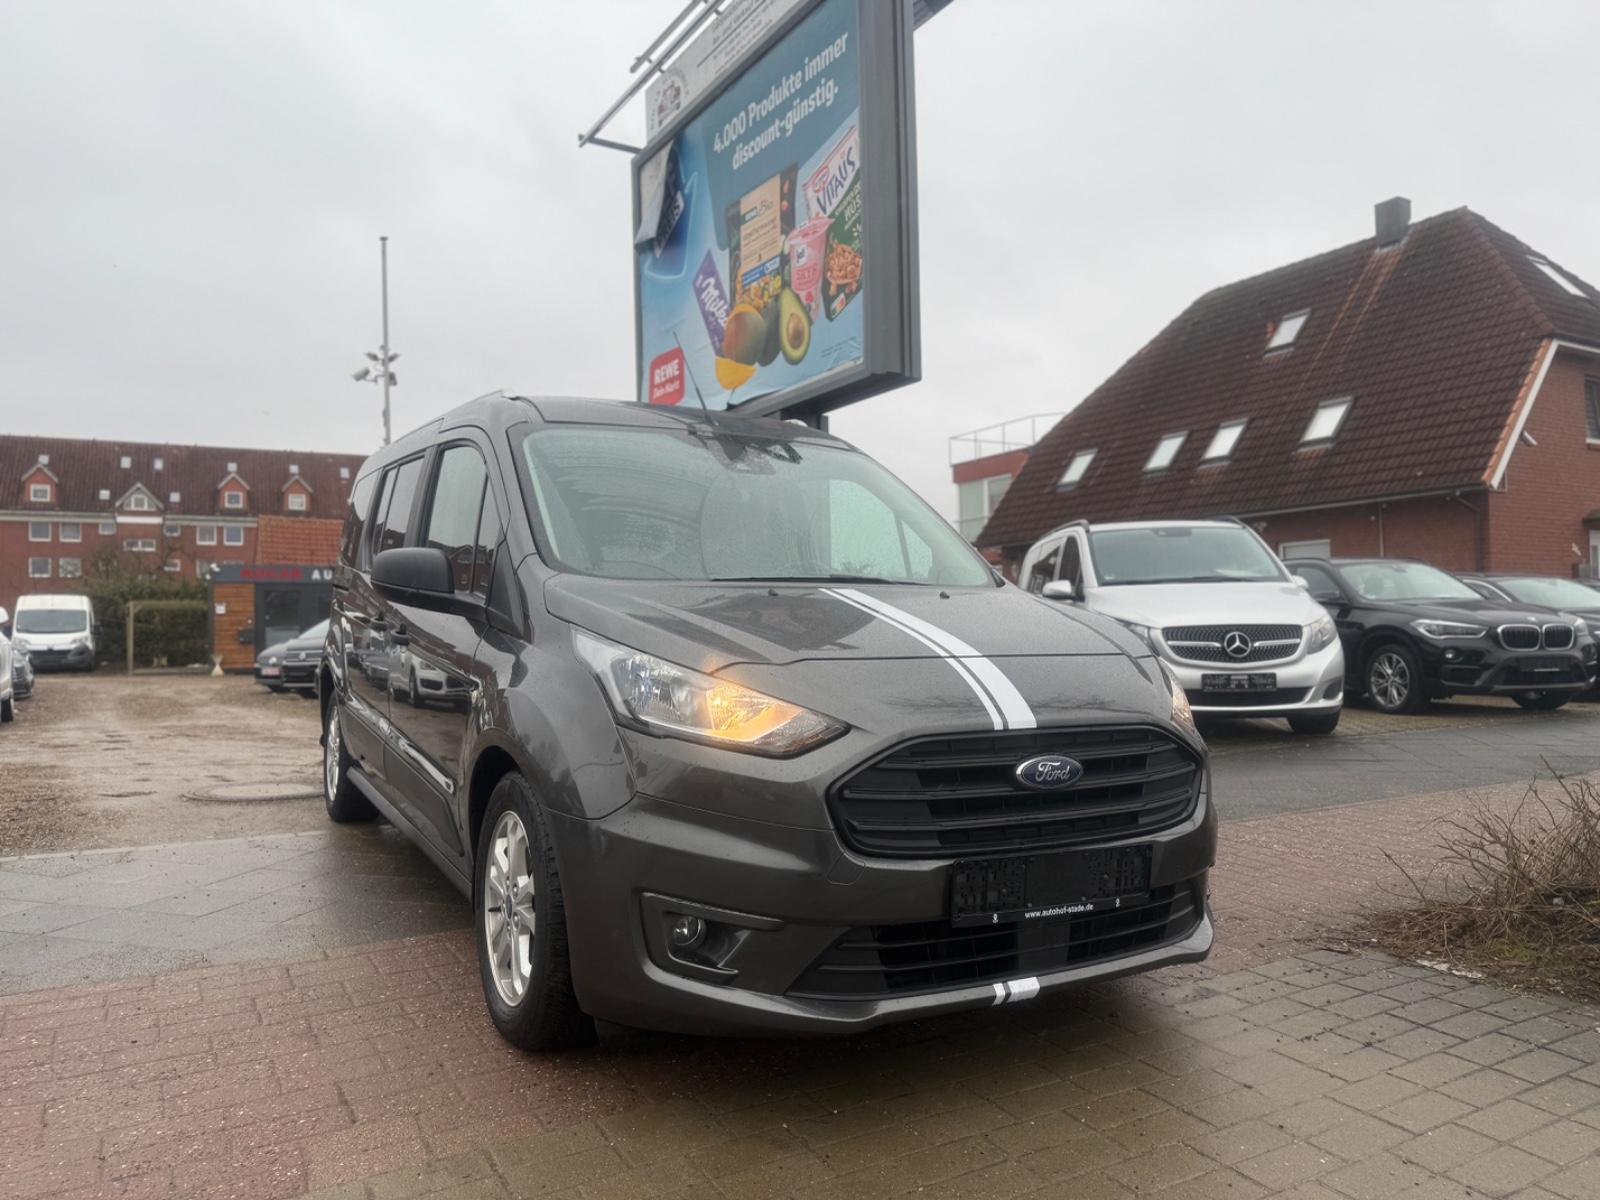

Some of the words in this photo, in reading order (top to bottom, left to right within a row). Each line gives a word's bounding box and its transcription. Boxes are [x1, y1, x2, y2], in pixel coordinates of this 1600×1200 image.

[713, 110, 746, 153] 4.000
[748, 69, 802, 127] Produkte
[804, 31, 848, 82] immer
[731, 78, 839, 170] discount-günstig.
[653, 359, 681, 385] REWE
[1035, 761, 1070, 782] Ford
[1024, 902, 1095, 919] www.autohof-stade.de
